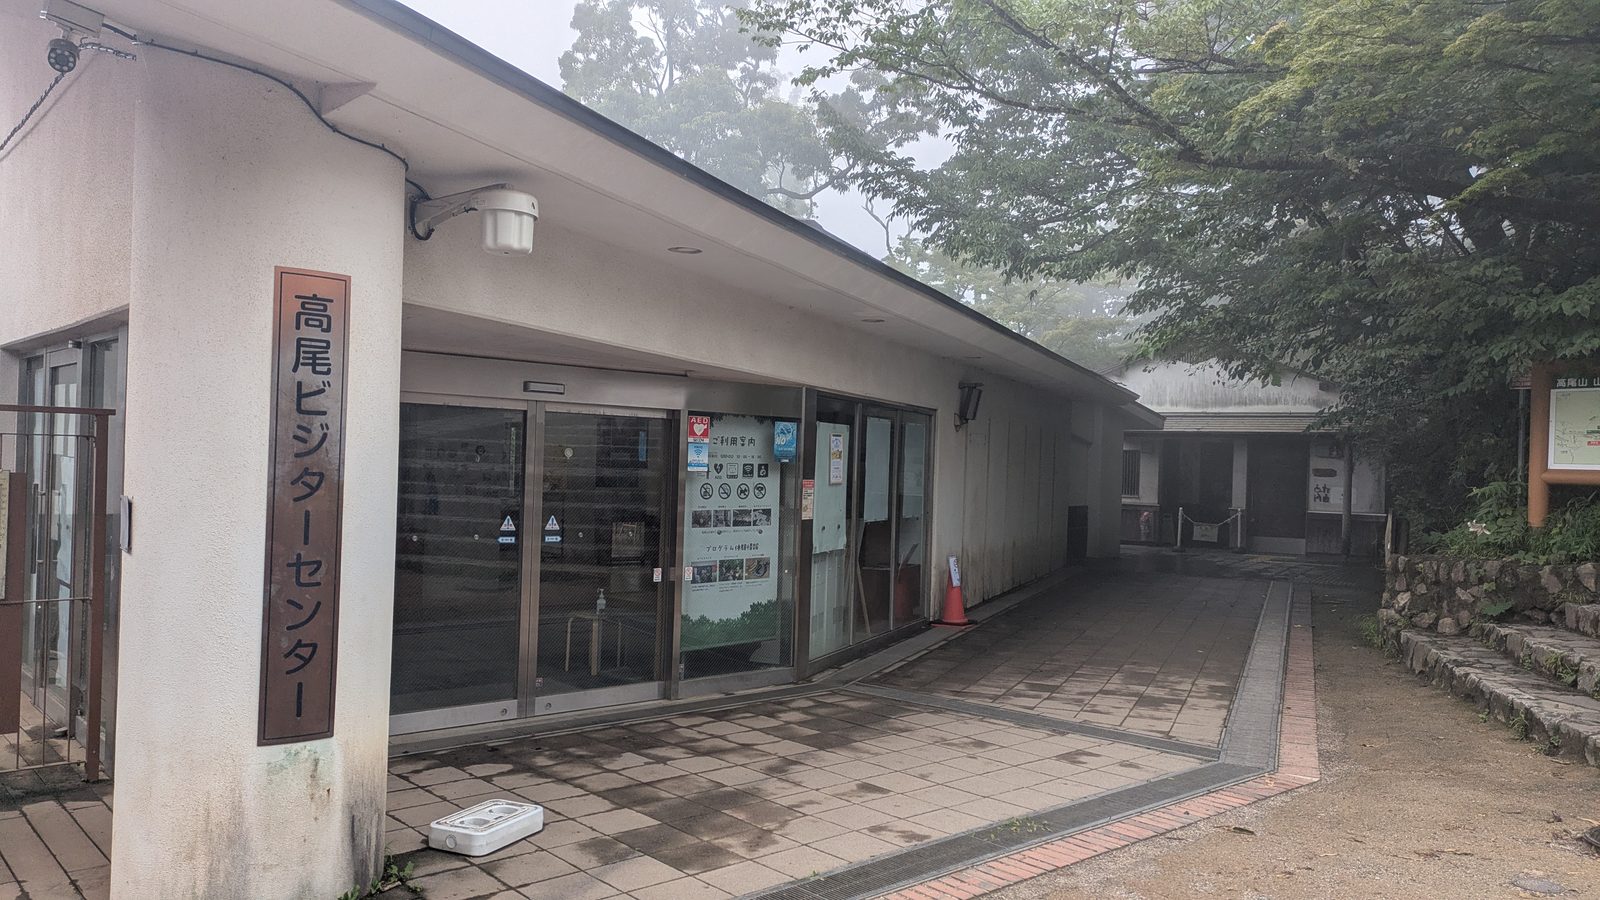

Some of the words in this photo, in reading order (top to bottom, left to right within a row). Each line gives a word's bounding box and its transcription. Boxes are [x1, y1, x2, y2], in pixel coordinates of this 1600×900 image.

[690, 416, 709, 424] AED
[712, 436, 756, 447] ご利用案内
[284, 293, 334, 718] 高尾ビジターセンター
